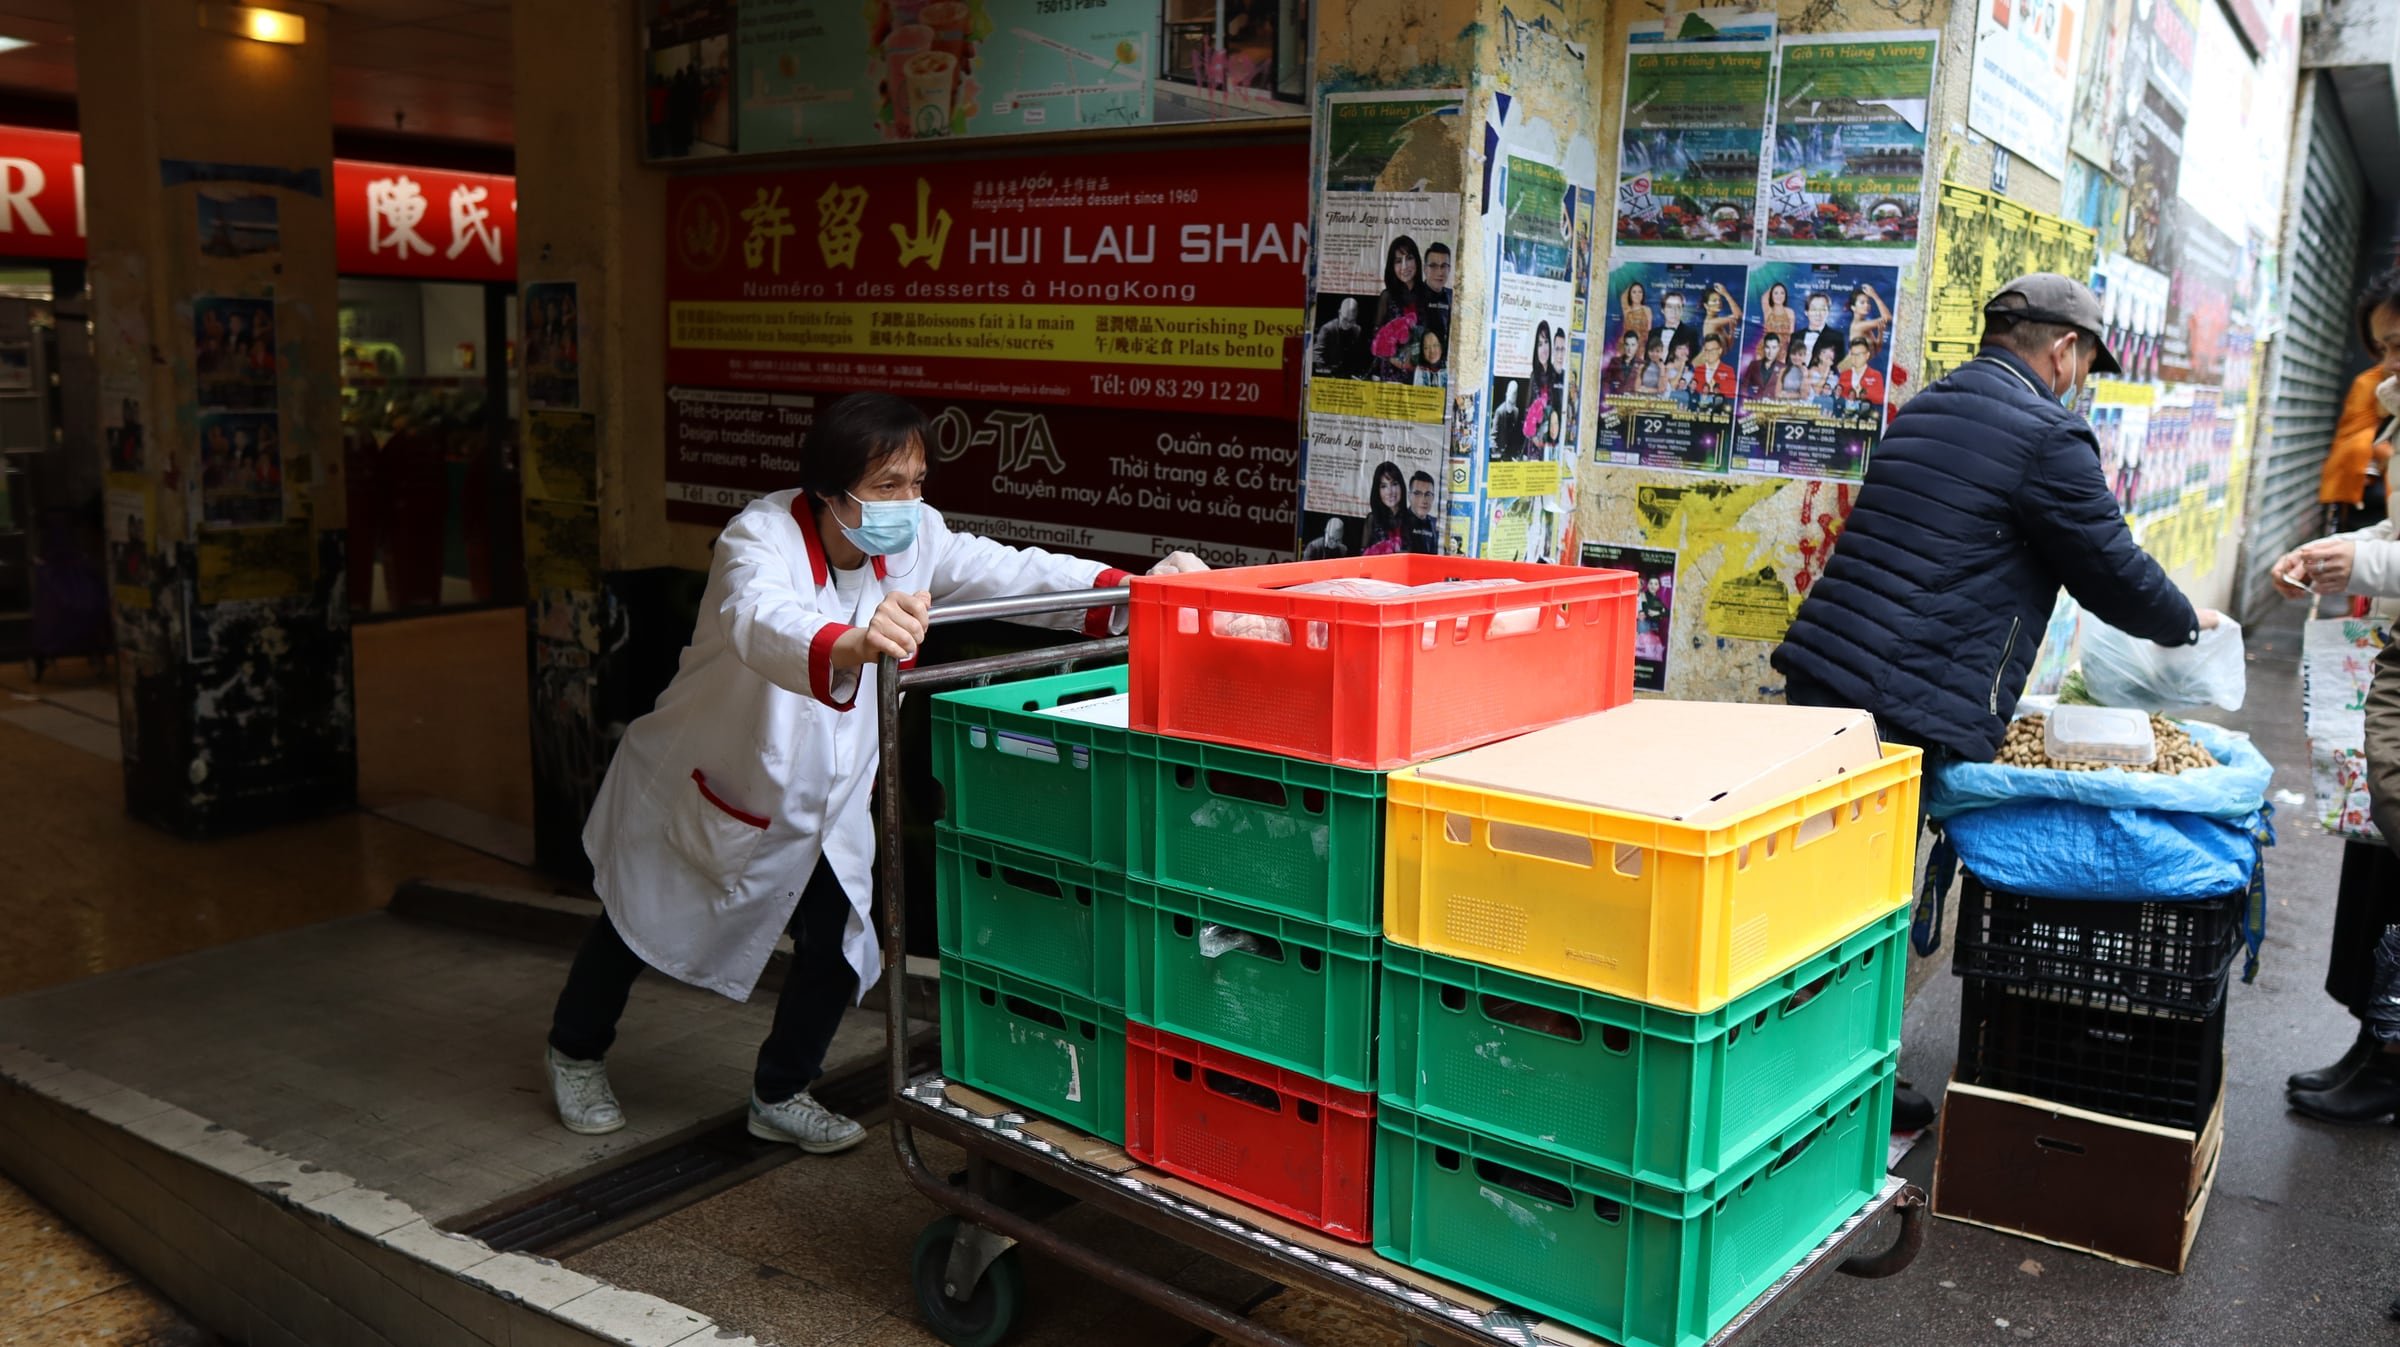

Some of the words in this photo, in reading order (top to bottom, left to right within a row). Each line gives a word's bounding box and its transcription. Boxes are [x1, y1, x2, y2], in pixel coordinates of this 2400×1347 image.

[1036, 0, 1071, 14] 75013
[1858, 178, 1893, 197] sông
[972, 197, 1024, 213] HongKong
[1028, 191, 1083, 208] handmade
[1087, 190, 1130, 206] dessert
[1134, 190, 1164, 205] since
[1168, 188, 1198, 204] 1960
[740, 176, 952, 275] 許留山
[1325, 211, 1358, 226] Thanh
[1359, 211, 1380, 227] Lan
[969, 227, 1042, 264] HUI
[1062, 224, 1156, 264] LAU
[743, 280, 824, 297] Numéro
[836, 281, 845, 297] 1
[855, 281, 895, 297] des
[905, 281, 1009, 297] desserts
[1021, 278, 1036, 297] à
[1049, 279, 1197, 303] HongKong
[823, 310, 852, 327] frais
[979, 313, 1002, 330] fait
[1006, 313, 1015, 330] à
[1019, 314, 1032, 330] la
[1037, 317, 1075, 331] main
[1179, 337, 1219, 356] Plats
[1225, 339, 1274, 358] bento
[1091, 374, 1124, 396] Tél:
[1129, 376, 1151, 396] 09
[1155, 378, 1177, 398] 83
[1181, 380, 1205, 399] 29
[1210, 381, 1232, 400] 12
[1236, 382, 1260, 402] 20
[679, 401, 764, 424] Prêt-à-porter
[679, 422, 719, 444] Design
[721, 426, 795, 449] traditionnel
[1644, 418, 1663, 433] 29
[1784, 424, 1805, 440] 29
[1217, 435, 1244, 459] áo
[1250, 446, 1297, 468] may
[1312, 432, 1342, 447] Thanh
[1344, 434, 1363, 452] Lan
[679, 446, 701, 464] Sur
[702, 453, 747, 468] mesure
[1154, 462, 1207, 487] trang
[1212, 466, 1230, 487] &
[1235, 463, 1264, 490] Cổ
[679, 485, 704, 500] Tél
[717, 491, 733, 503] 01
[991, 474, 1056, 500] Chuyên
[1061, 486, 1102, 507] may
[1105, 482, 1133, 506] Áo
[1138, 486, 1171, 511] Dài
[1176, 490, 1202, 514] và
